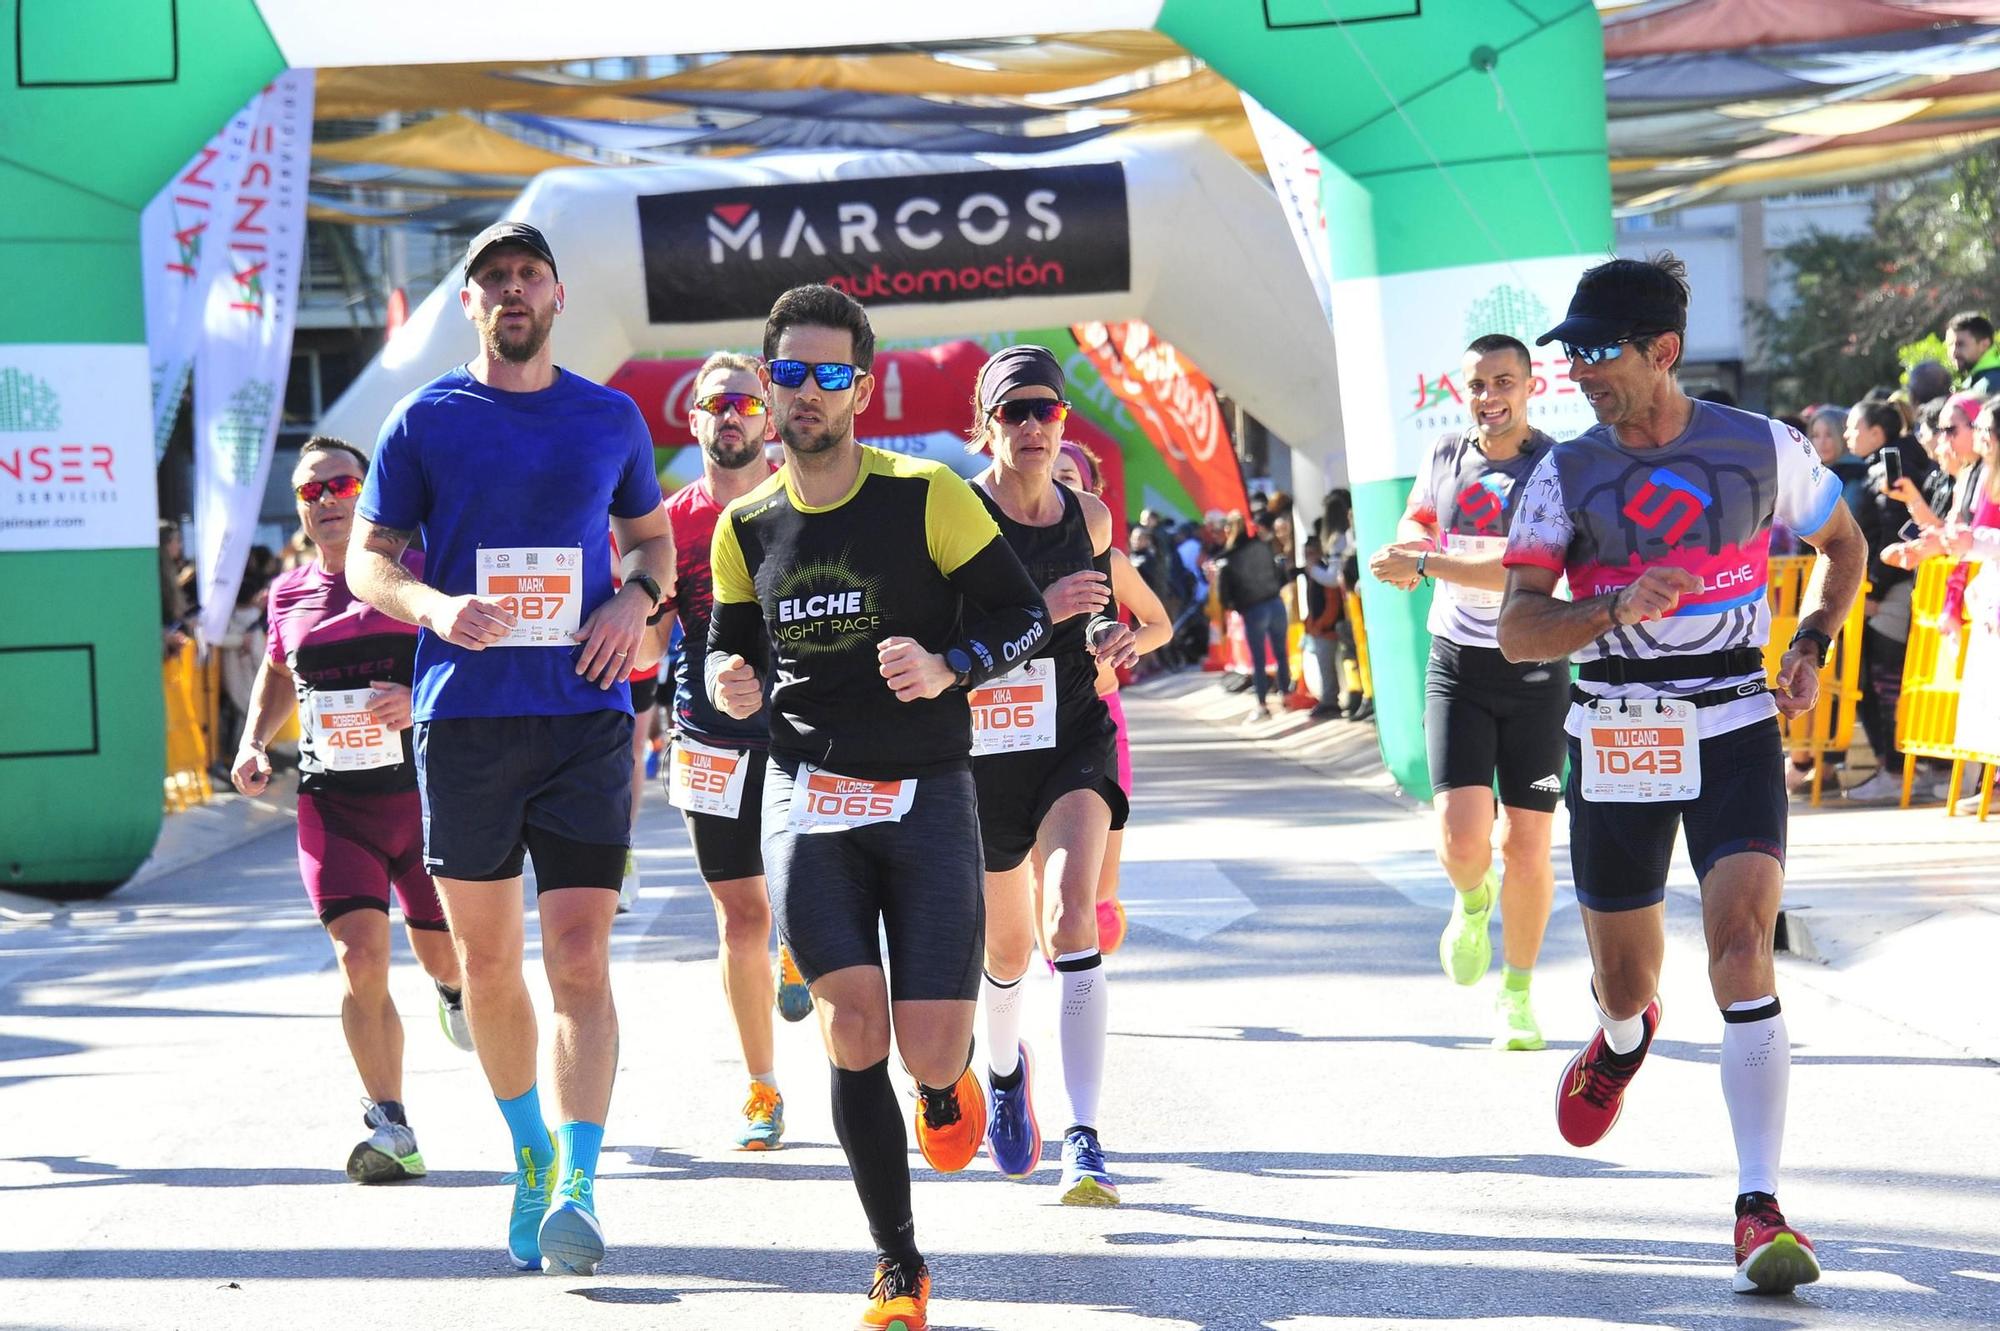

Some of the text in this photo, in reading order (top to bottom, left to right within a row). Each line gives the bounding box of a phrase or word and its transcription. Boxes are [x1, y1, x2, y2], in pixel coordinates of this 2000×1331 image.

[164, 128, 225, 281] JAIN
[229, 82, 277, 317] JAINSE
[706, 189, 1063, 265] MARCOS
[518, 577, 545, 592] MARK
[1703, 563, 1754, 592] LCHE
[502, 596, 565, 620] 987
[779, 591, 862, 622] ELCHE
[774, 616, 881, 641] NIGHT RACE
[1002, 620, 1044, 662] Orona
[992, 688, 1013, 704] KIKA
[972, 705, 1035, 731] 1106
[327, 727, 384, 749] 462
[1615, 730, 1659, 746] MJ CANO
[692, 754, 713, 770] LUNA
[1595, 749, 1682, 775] 1043
[835, 779, 875, 793] KLOPEZ
[806, 792, 894, 817] 1065
